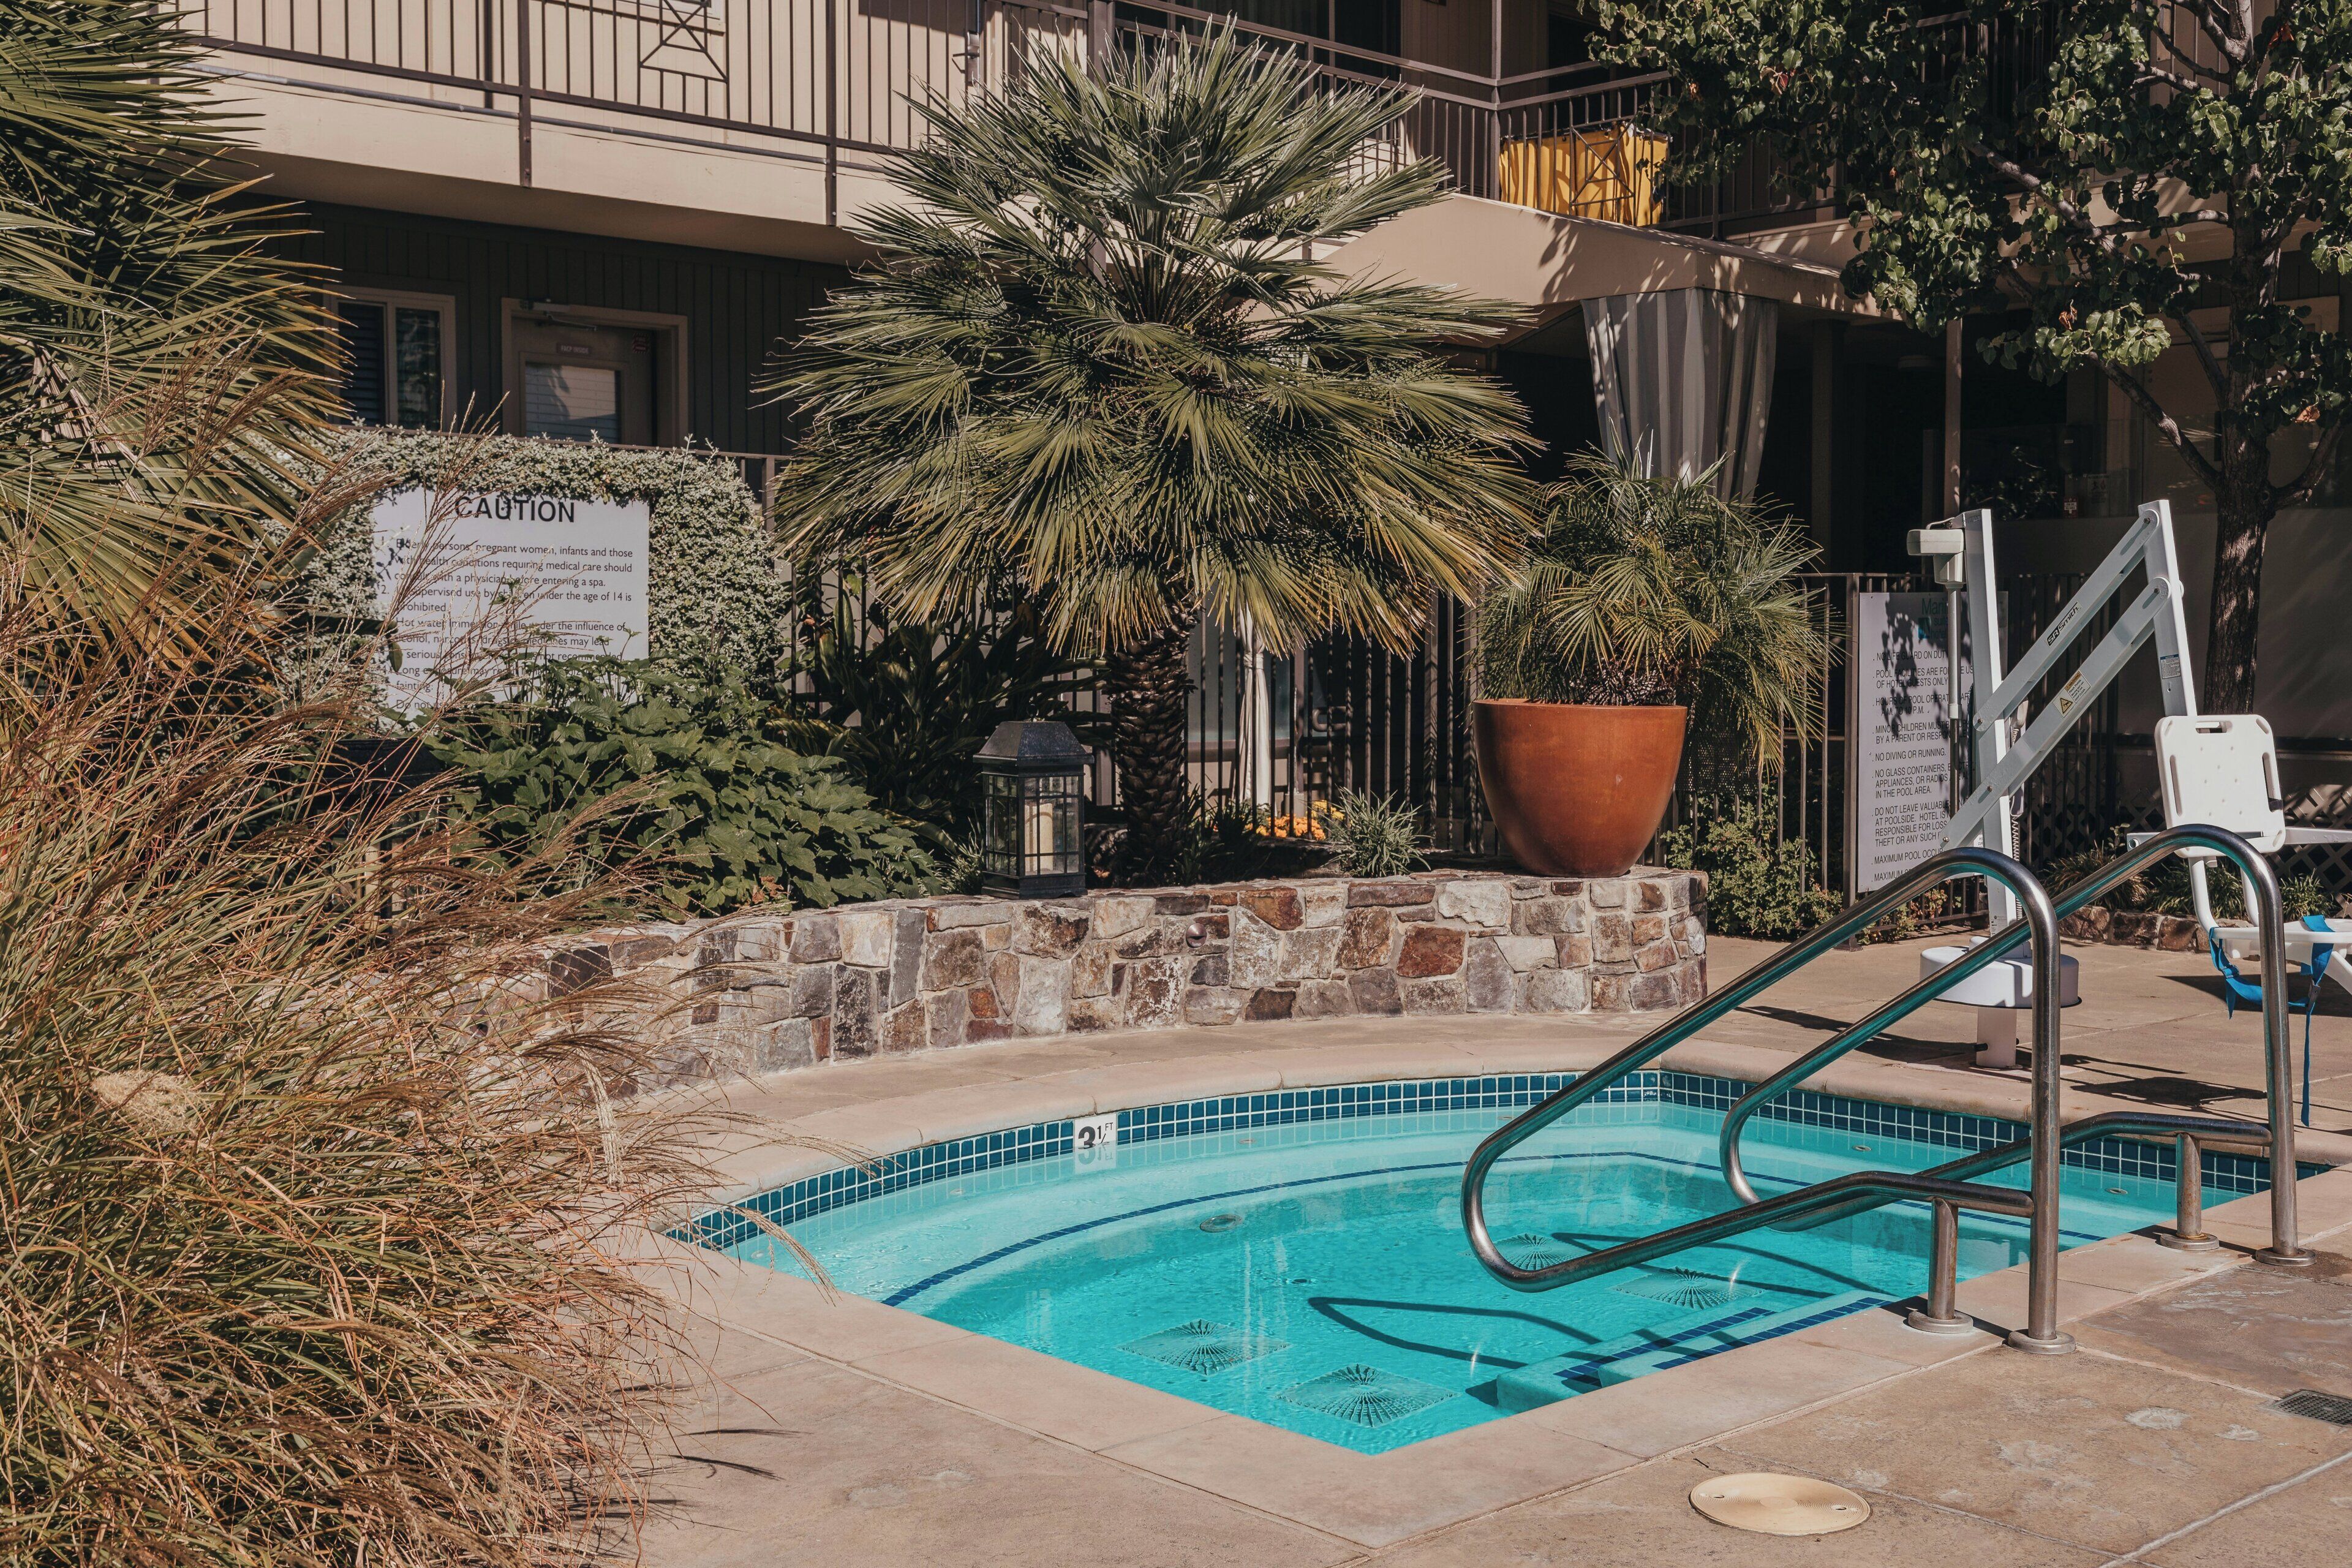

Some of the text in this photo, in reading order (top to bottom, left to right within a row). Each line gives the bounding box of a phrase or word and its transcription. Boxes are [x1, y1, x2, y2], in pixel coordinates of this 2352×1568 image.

[455, 496, 575, 522] CAUTION
[396, 537, 429, 551] Edery
[476, 544, 517, 555] pregnant
[519, 546, 557, 556] women,
[560, 545, 589, 556] infants
[590, 548, 607, 557] and
[609, 548, 633, 557] those
[394, 556, 633, 573] wth health conditions requiring medical care should
[394, 571, 430, 581] coul
[434, 573, 453, 582] ith
[465, 573, 507, 585] physician
[509, 575, 540, 585] efore
[542, 577, 579, 588] entering
[589, 579, 606, 589] spa.
[380, 584, 390, 595] 2.
[484, 588, 496, 600] by
[566, 590, 581, 600] the
[583, 593, 598, 603] age
[601, 592, 611, 601] of
[613, 592, 623, 601] 14
[625, 592, 632, 601] is
[401, 602, 447, 613] rohibited
[396, 617, 415, 627] Hot
[450, 620, 498, 629] mmeion
[502, 620, 526, 630] hile
[530, 620, 556, 630] der
[558, 622, 573, 630] the
[575, 621, 614, 631] influence
[617, 622, 627, 631] of
[2048, 606, 2078, 645] SR Smith
[398, 634, 431, 645] cohol,
[523, 636, 568, 646] medines
[570, 637, 589, 648] may
[407, 650, 441, 660] serious
[557, 652, 624, 662] recommened.
[1876, 652, 1886, 661] NO
[1887, 651, 1899, 662] LIFE
[1923, 650, 1932, 659] ON
[423, 666, 469, 677] eosure
[1875, 668, 1893, 678] POOL
[1926, 667, 1938, 676] ARE
[1876, 679, 1885, 689] OF
[1886, 679, 1907, 688] HOTEL
[1907, 677, 1931, 688] GUESTS
[396, 699, 411, 709] Do
[1875, 697, 1897, 707] HOURS
[1909, 695, 1924, 704] POOL
[1926, 693, 1950, 703] OPERAT
[1895, 707, 1903, 715] TO
[1913, 706, 1924, 715] P.M.
[1875, 725, 1896, 734] MINOR
[1897, 722, 1927, 733] CHILDREN
[1928, 721, 1944, 730] MUST
[1875, 735, 1884, 744] BY
[1885, 735, 1890, 744] A
[1891, 733, 1915, 744] PARENT
[1916, 733, 1926, 742] OR
[1875, 747, 1947, 762] NO DIVING OR RUNNING.
[1875, 769, 1885, 778] NO
[1885, 766, 1905, 777] GLASS
[1907, 764, 1947, 776] CONTAINERS,
[1875, 777, 1915, 789] APPLIANCES,
[1915, 775, 1925, 786] OR
[1926, 772, 1948, 783] RADIOS
[1875, 785, 1932, 799] IN THE POOL AREA.
[1874, 807, 1884, 816] DO
[1885, 805, 1898, 815] NOT
[1899, 803, 1918, 813] LEAVE
[1920, 800, 1950, 811] VALUABLE
[1875, 817, 1883, 827] AT
[1884, 813, 1917, 826] POOLSIDE.
[1919, 811, 1939, 822] HOTEL
[1940, 810, 1946, 820] IS
[1875, 823, 1917, 837] RESPONSIBLE
[1918, 822, 1931, 832] FOR
[1875, 836, 1894, 848] THEFT
[1896, 835, 1905, 845] OR
[1906, 834, 1918, 844] ANY
[1920, 831, 1936, 842] SUCH
[1874, 852, 1903, 865] MAXIMUM
[1904, 850, 1921, 861] POOL
[1874, 870, 1903, 883] MAXIMUM
[1105, 1122, 1114, 1131] FT
